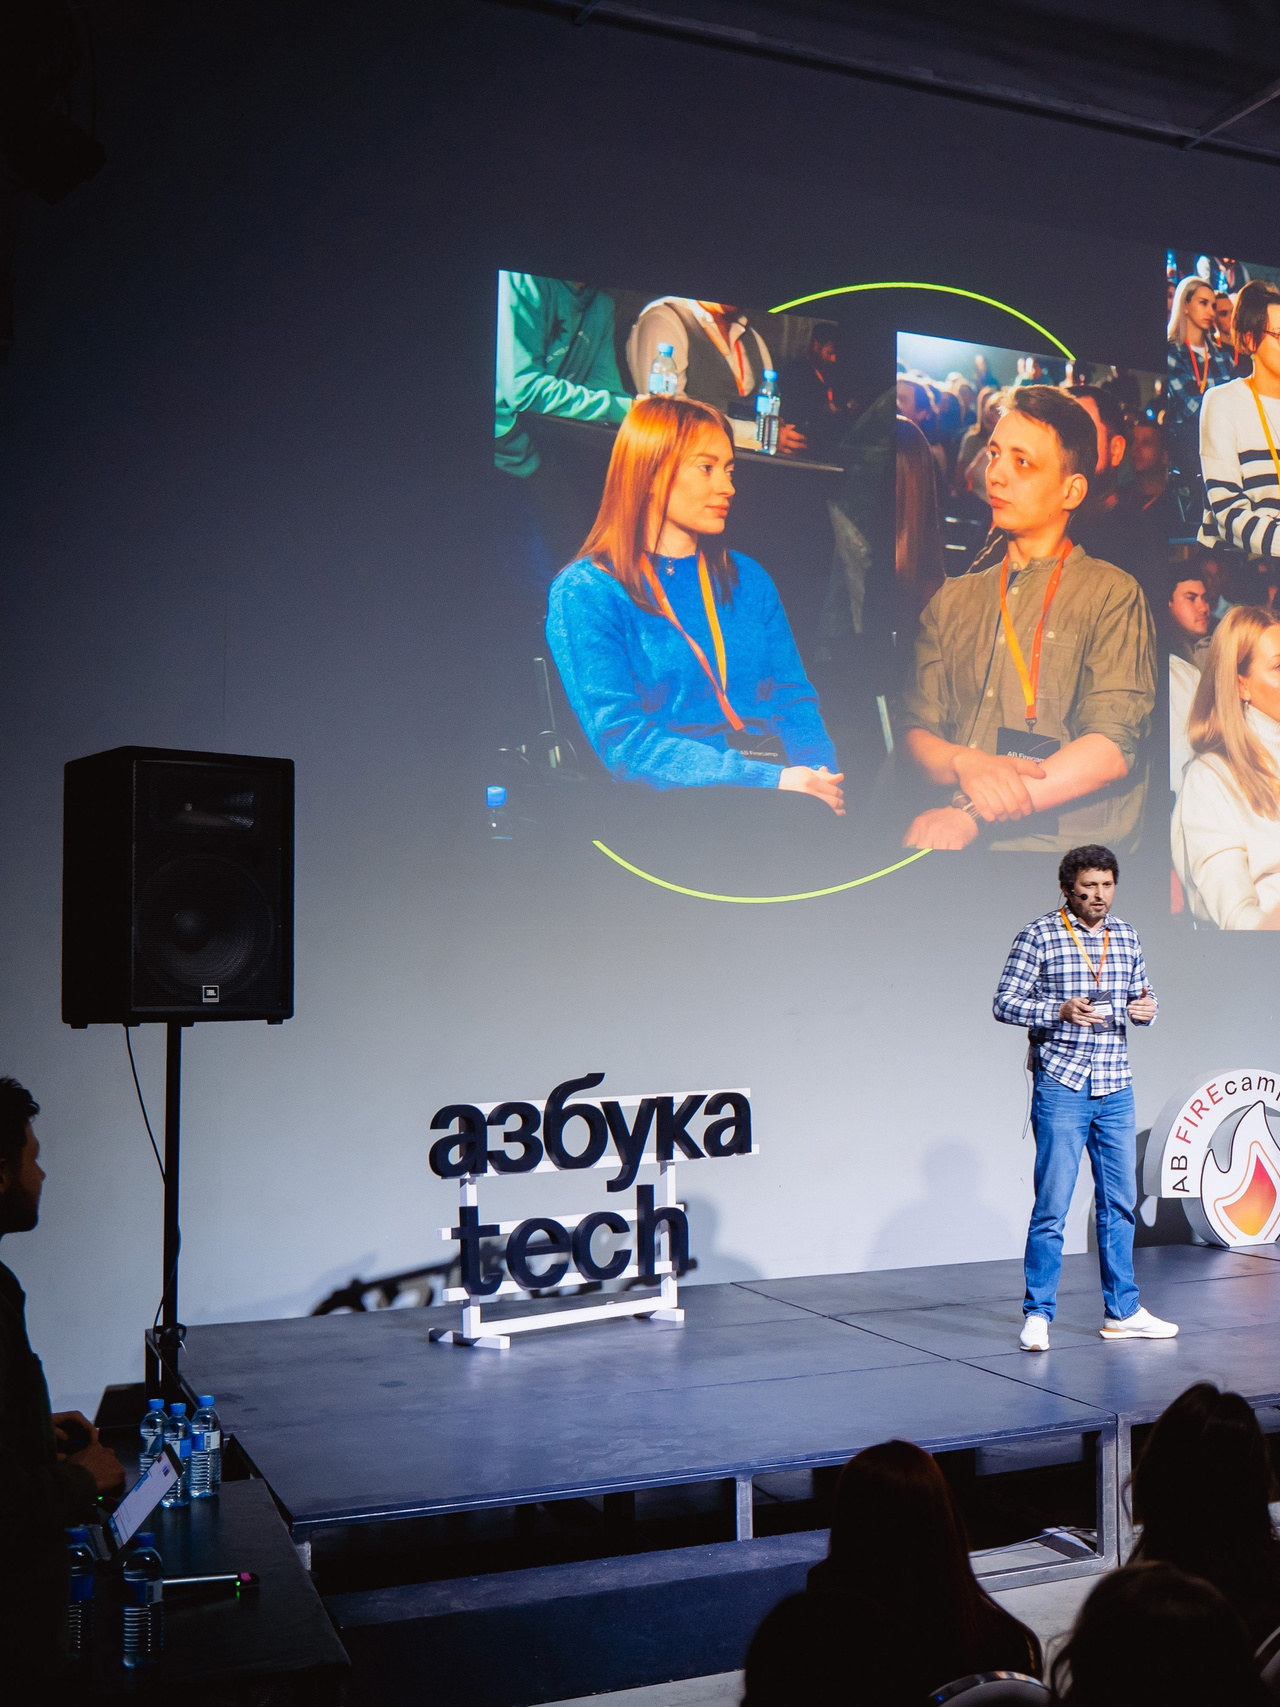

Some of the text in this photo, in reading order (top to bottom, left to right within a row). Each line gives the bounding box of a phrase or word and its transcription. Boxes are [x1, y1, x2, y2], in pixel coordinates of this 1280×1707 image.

[429, 1072, 753, 1193] азбука
[1170, 1155, 1190, 1193] AB
[451, 1184, 689, 1296] tech
